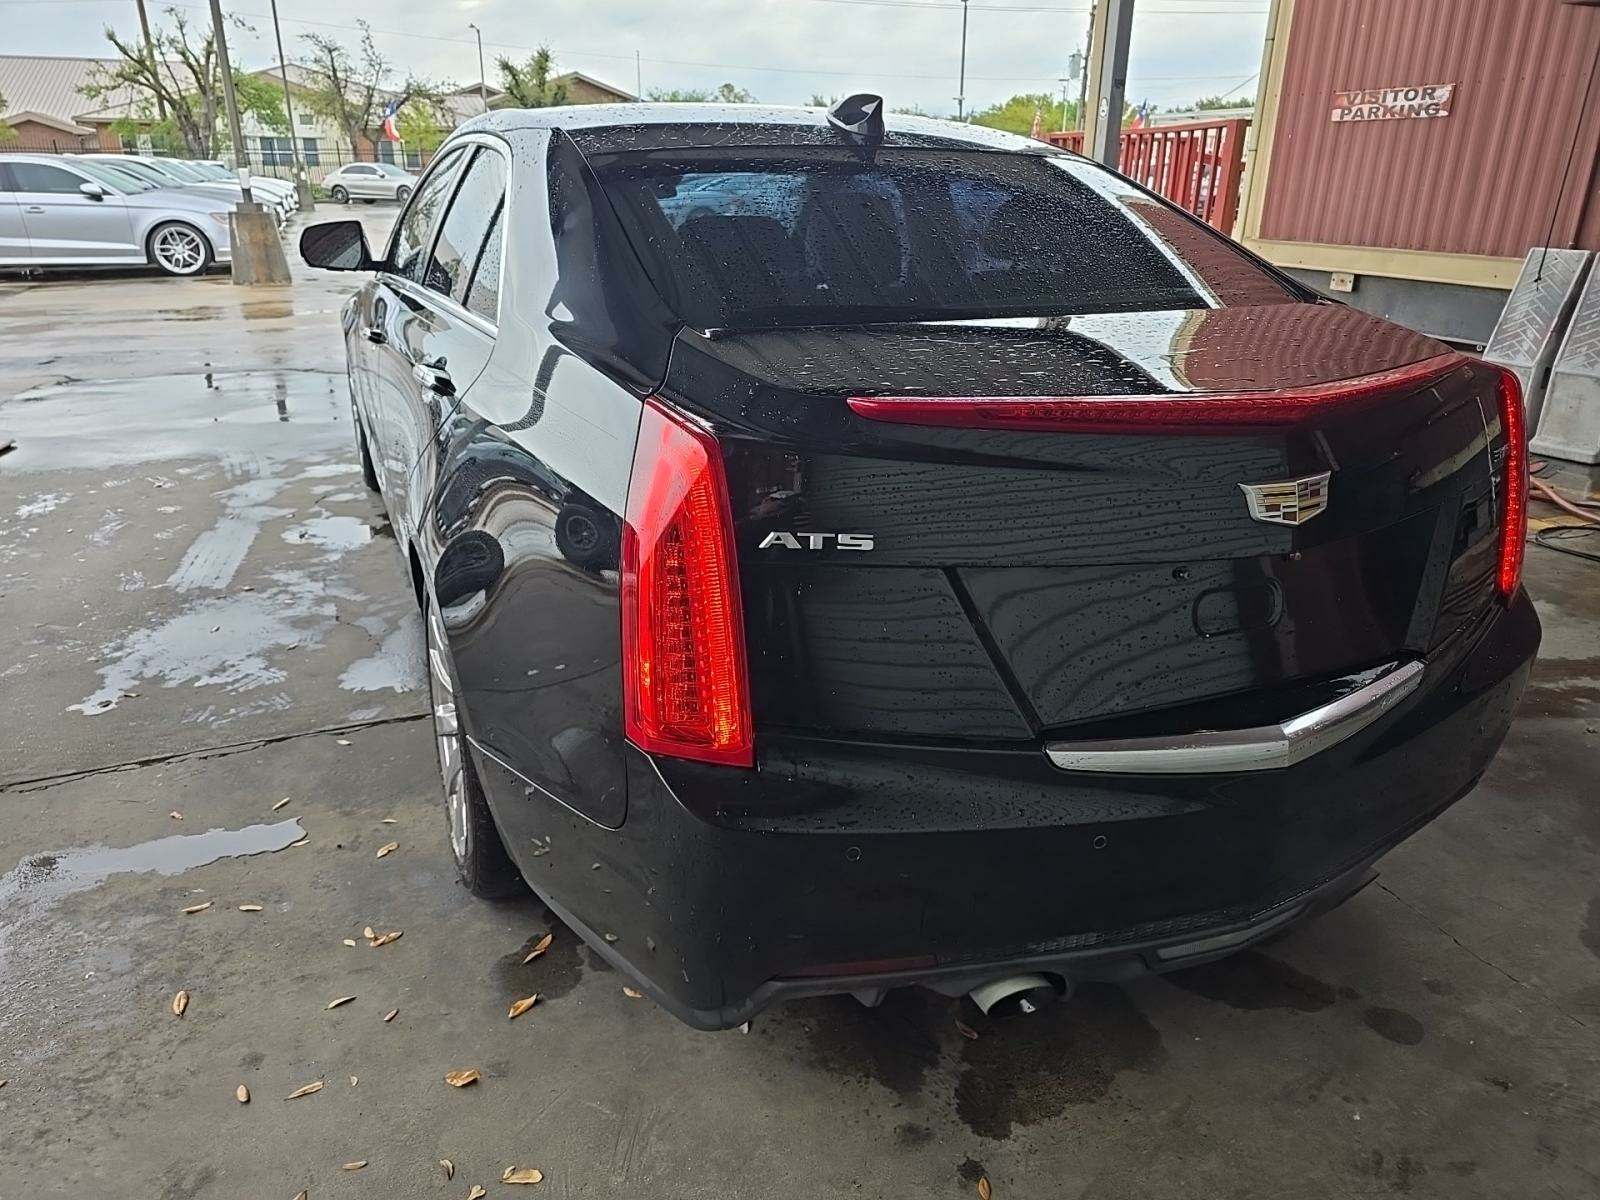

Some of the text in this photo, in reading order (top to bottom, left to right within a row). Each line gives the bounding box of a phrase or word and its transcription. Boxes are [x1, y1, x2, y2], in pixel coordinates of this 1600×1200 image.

[1344, 87, 1437, 106] VISITOR
[1340, 102, 1441, 120] PARKING
[758, 531, 874, 551] ATS
